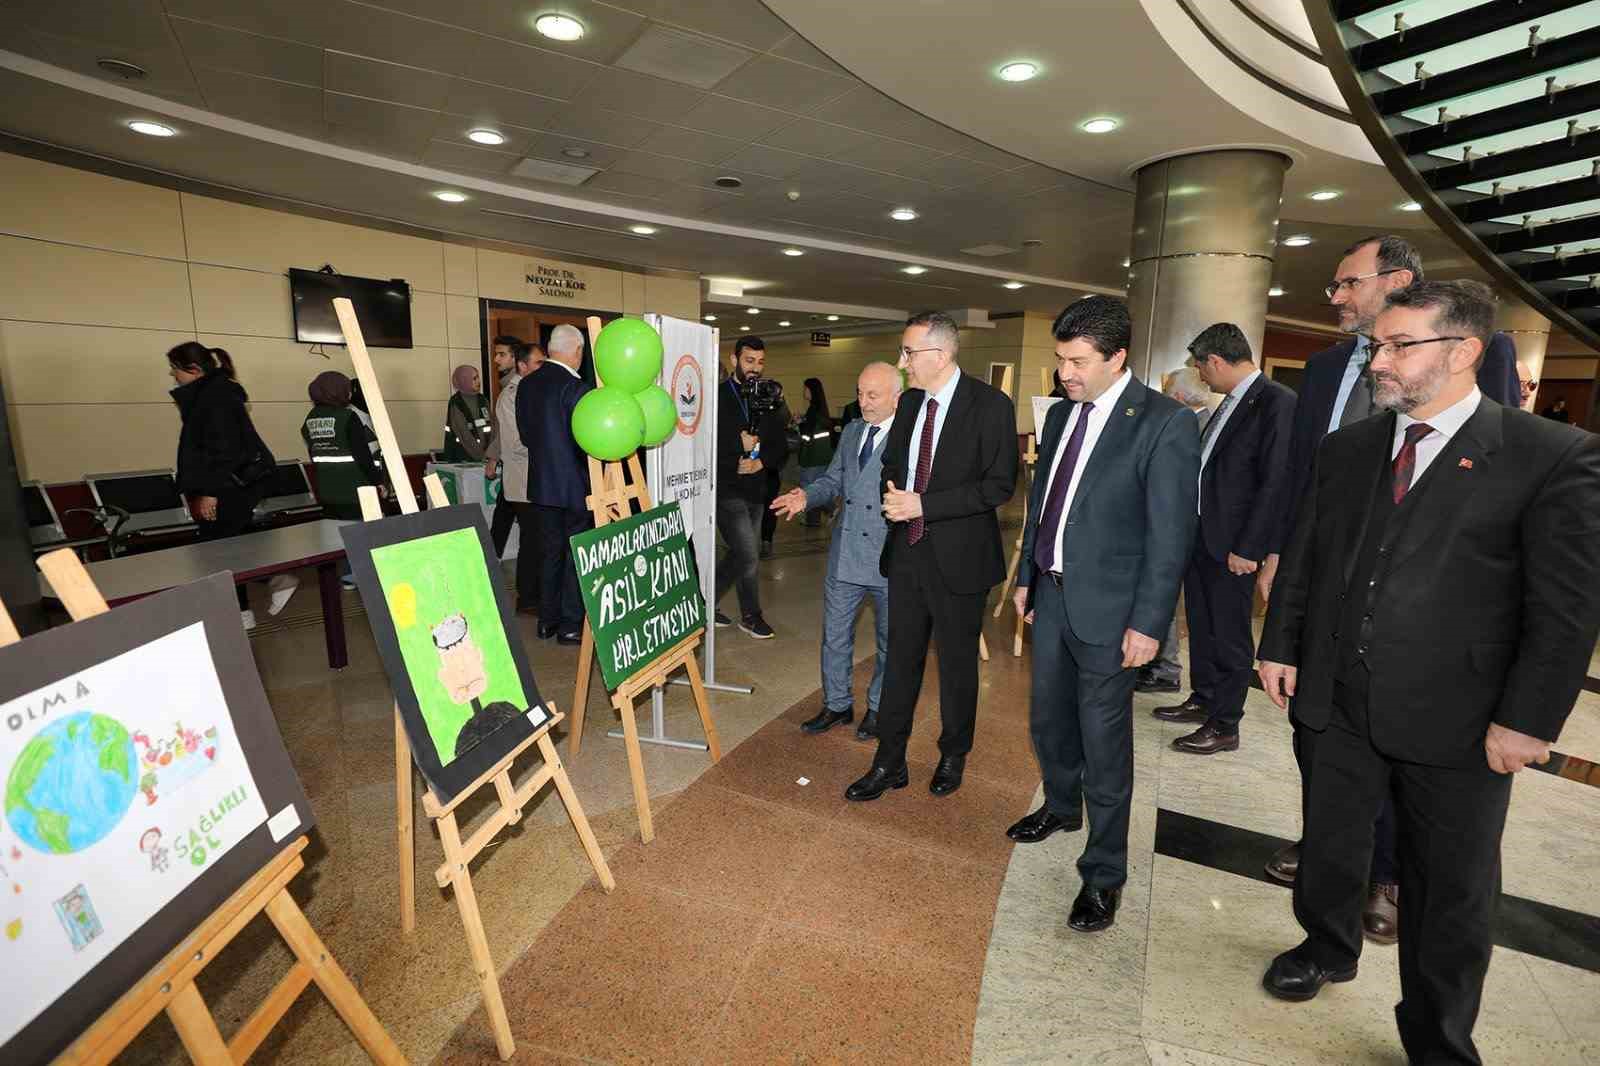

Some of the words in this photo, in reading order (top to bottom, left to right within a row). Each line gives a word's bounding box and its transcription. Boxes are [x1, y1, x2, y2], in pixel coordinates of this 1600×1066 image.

[526, 274, 564, 287] NEVZAT
[566, 279, 586, 290] KOR
[539, 286, 575, 298] SALONU
[649, 547, 690, 599] KANI
[7, 680, 90, 731] OLMA
